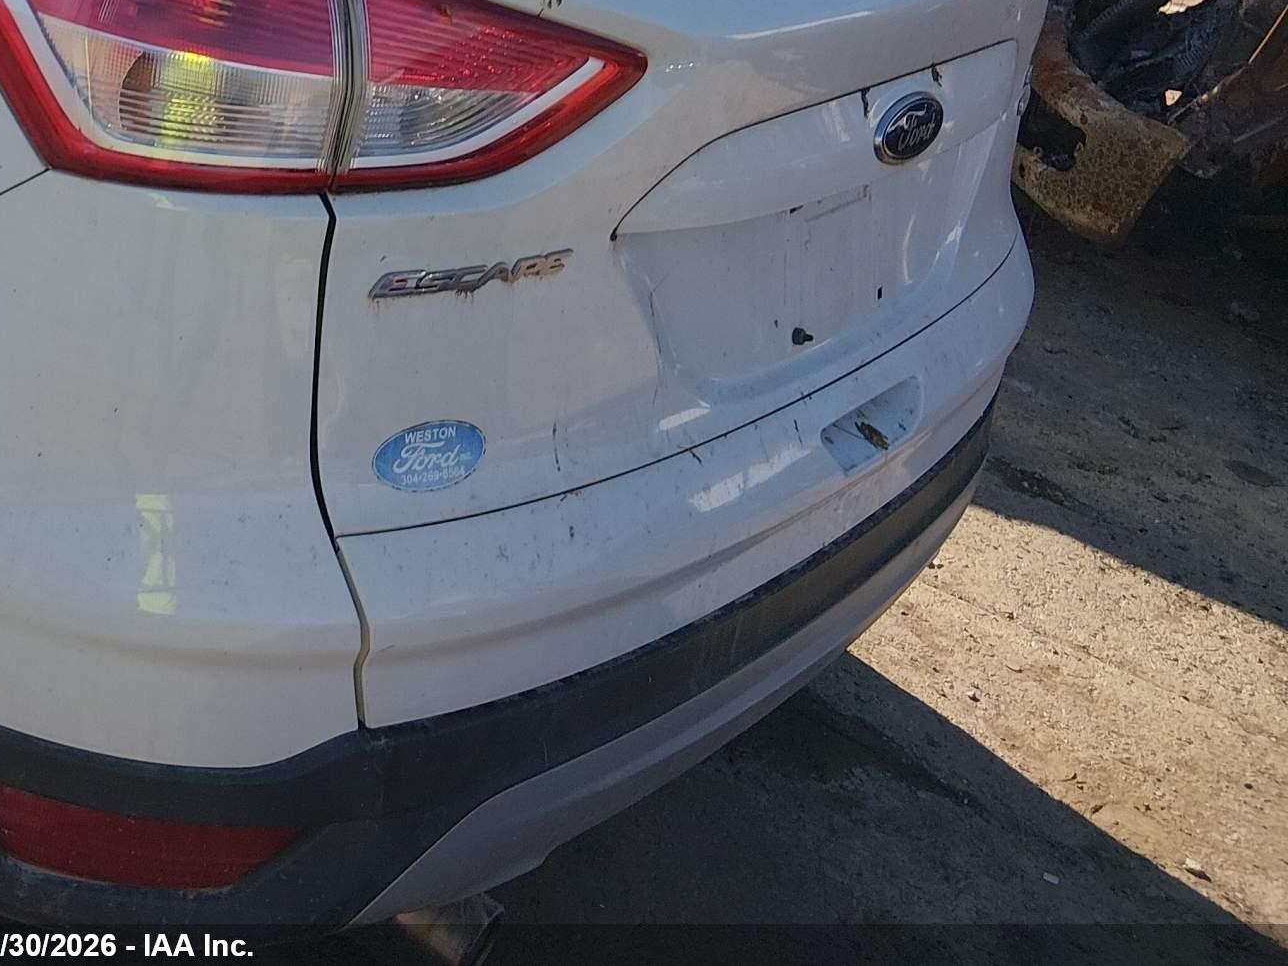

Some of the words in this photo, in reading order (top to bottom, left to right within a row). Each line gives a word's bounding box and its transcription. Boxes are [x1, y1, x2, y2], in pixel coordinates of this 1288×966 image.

[368, 247, 574, 300] ESCAPE
[404, 425, 457, 444] WESTON
[392, 440, 461, 474] Ford
